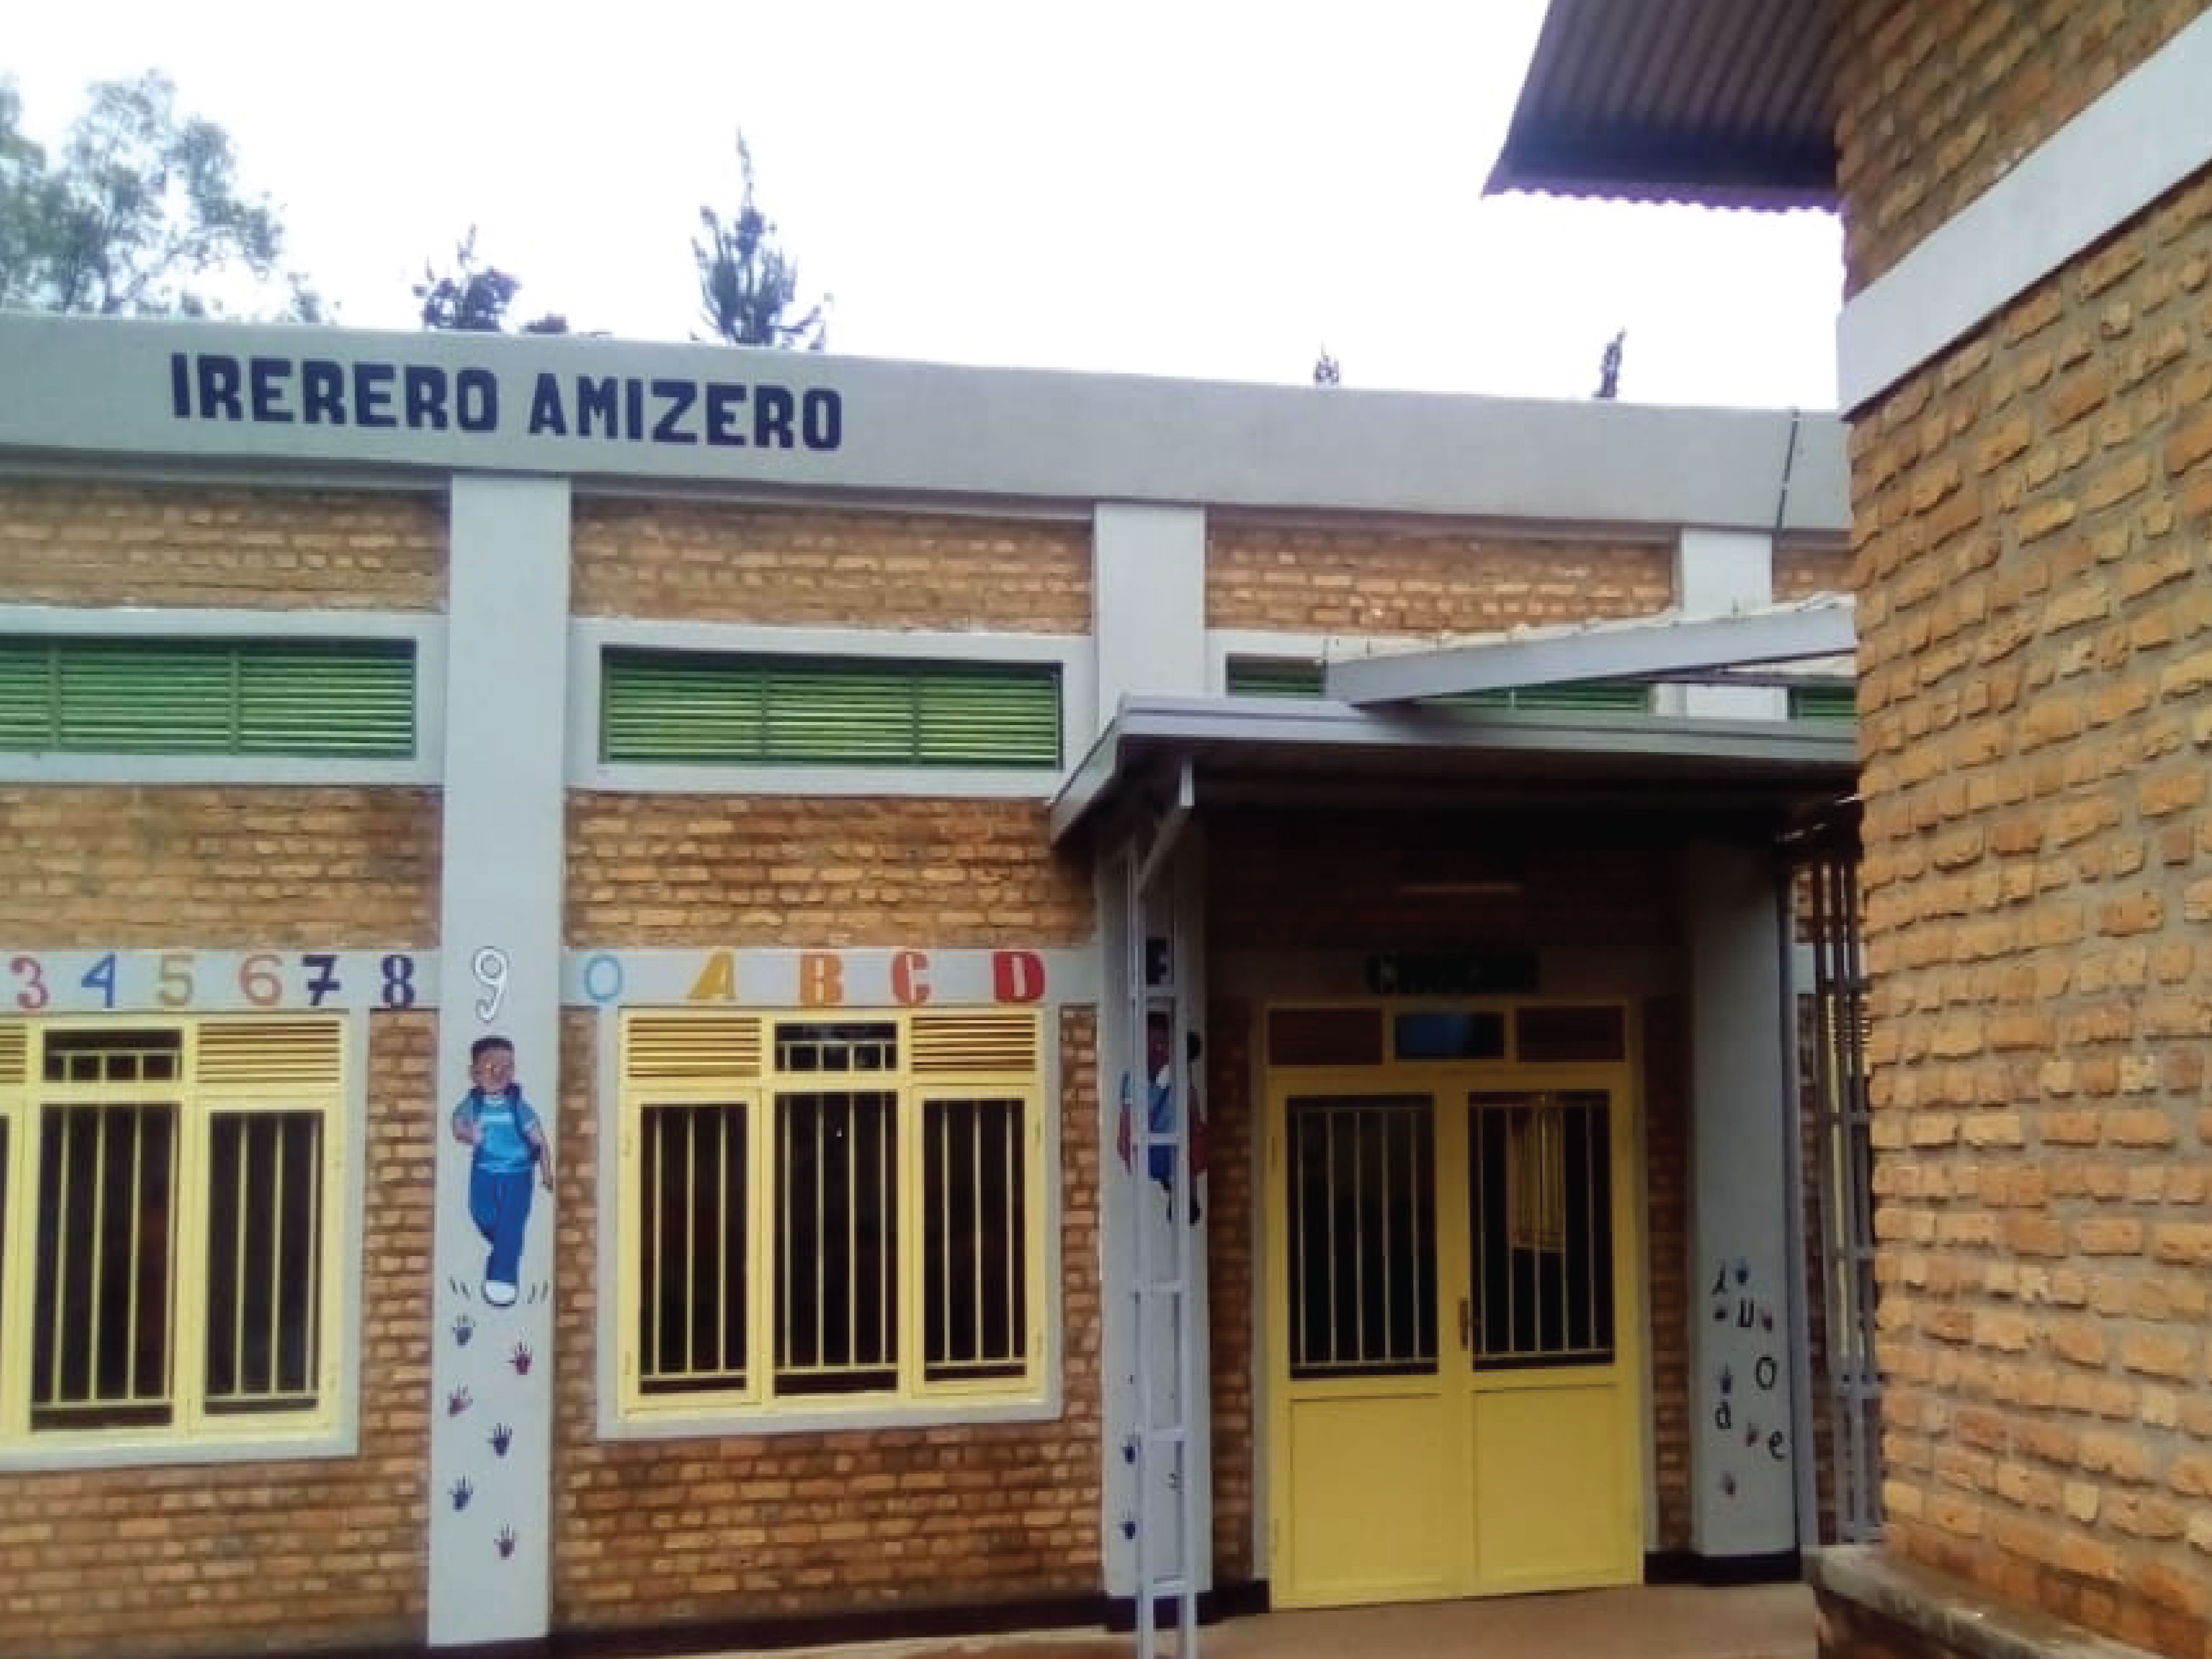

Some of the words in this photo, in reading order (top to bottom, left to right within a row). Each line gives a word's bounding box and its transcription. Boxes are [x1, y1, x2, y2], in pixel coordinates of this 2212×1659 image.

[171, 352, 499, 433] IRERERO
[528, 373, 842, 451] AMIZERO
[9, 956, 48, 1009] 3
[81, 952, 116, 1009] 4
[158, 955, 194, 1008] 5
[239, 954, 283, 1006] 6
[302, 954, 341, 1006] 7
[380, 954, 415, 1010] 8
[472, 946, 509, 1024] 9
[686, 951, 736, 1002] A
[799, 951, 844, 1008] B
[891, 951, 930, 1007] C
[993, 949, 1046, 1005] D
